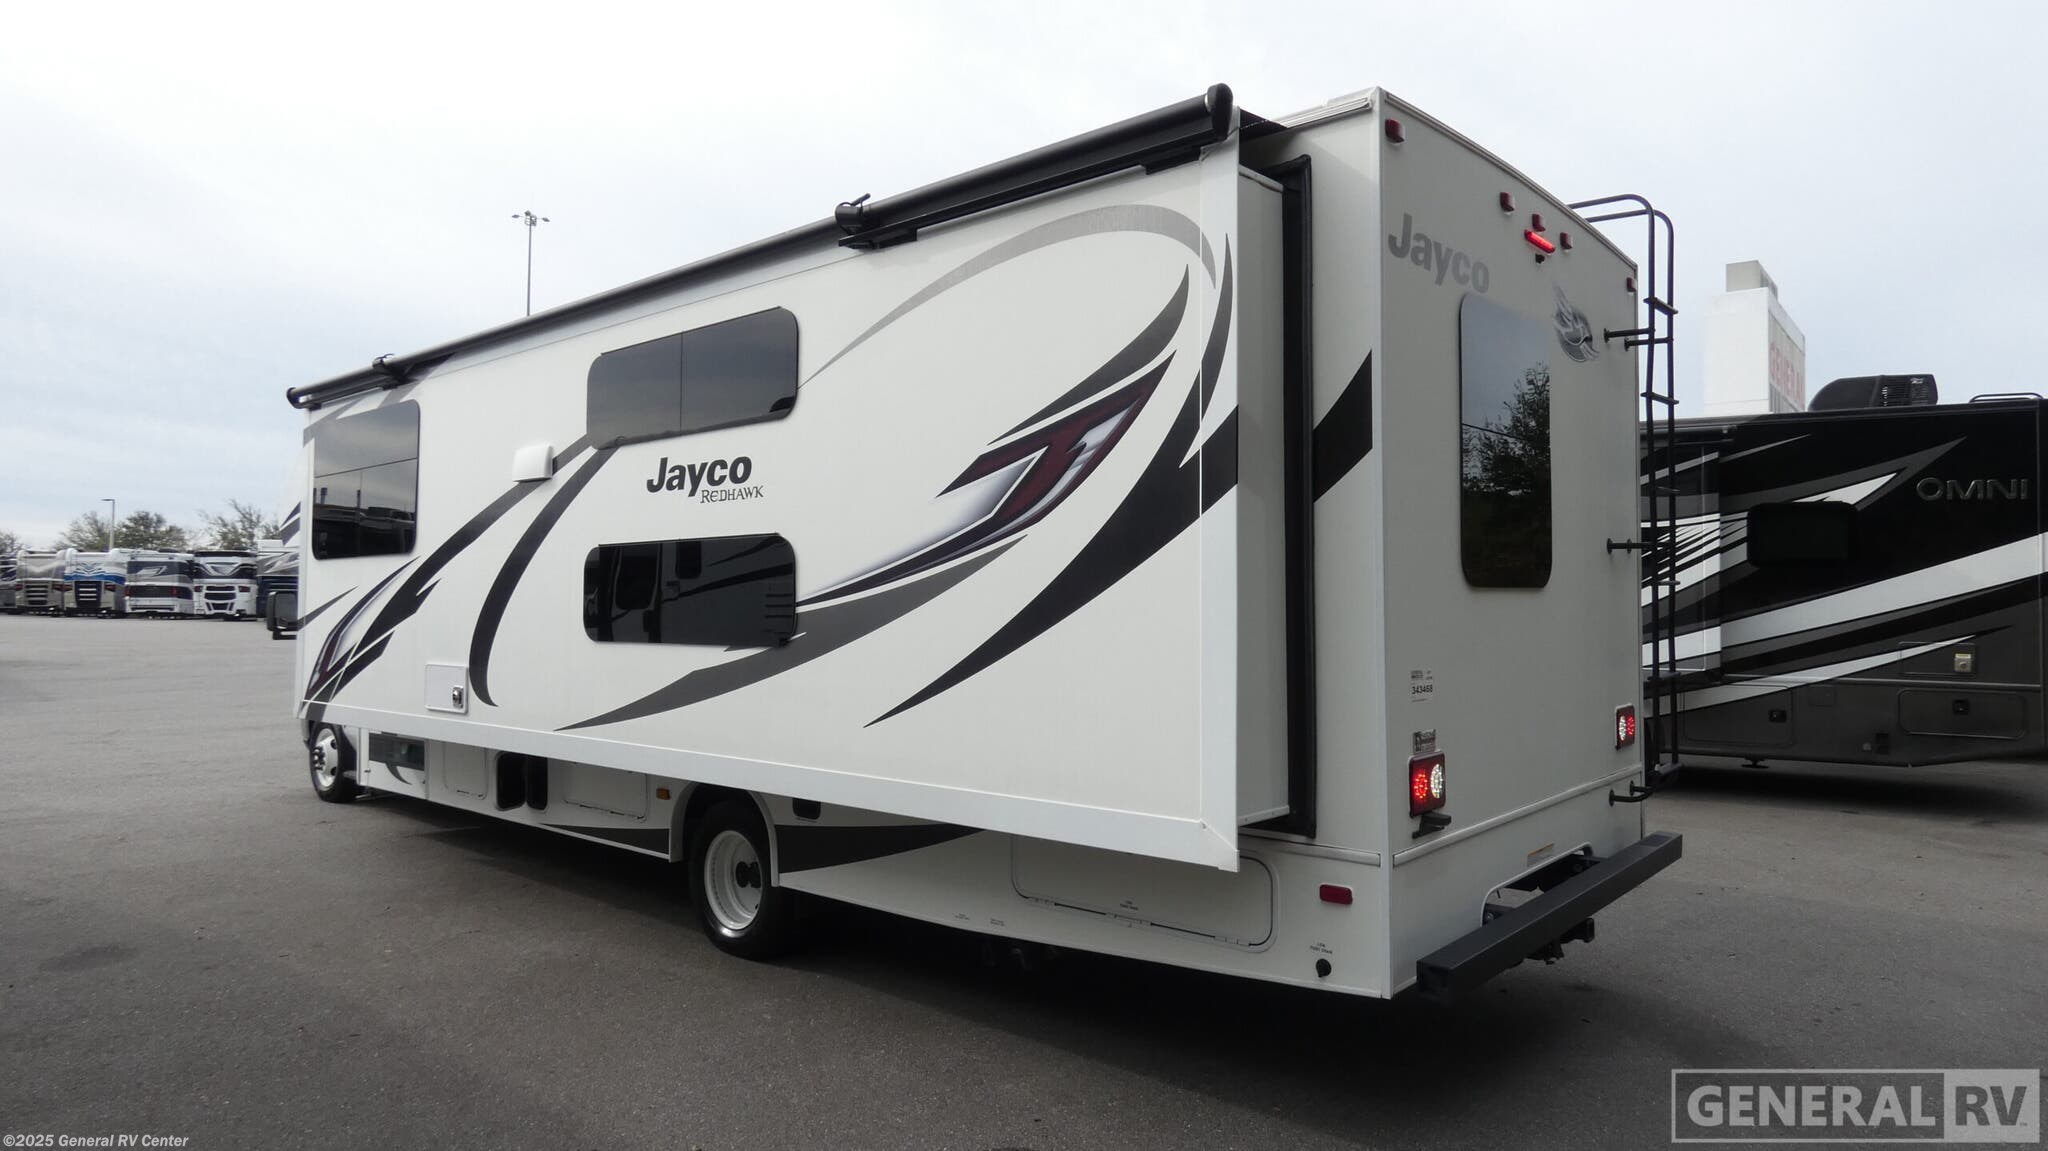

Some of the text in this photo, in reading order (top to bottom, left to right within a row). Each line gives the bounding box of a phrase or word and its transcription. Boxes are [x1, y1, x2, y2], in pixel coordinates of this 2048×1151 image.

[1388, 212, 1489, 294] Jayco
[646, 456, 752, 498] Jayco
[1916, 477, 2028, 501] OMNI
